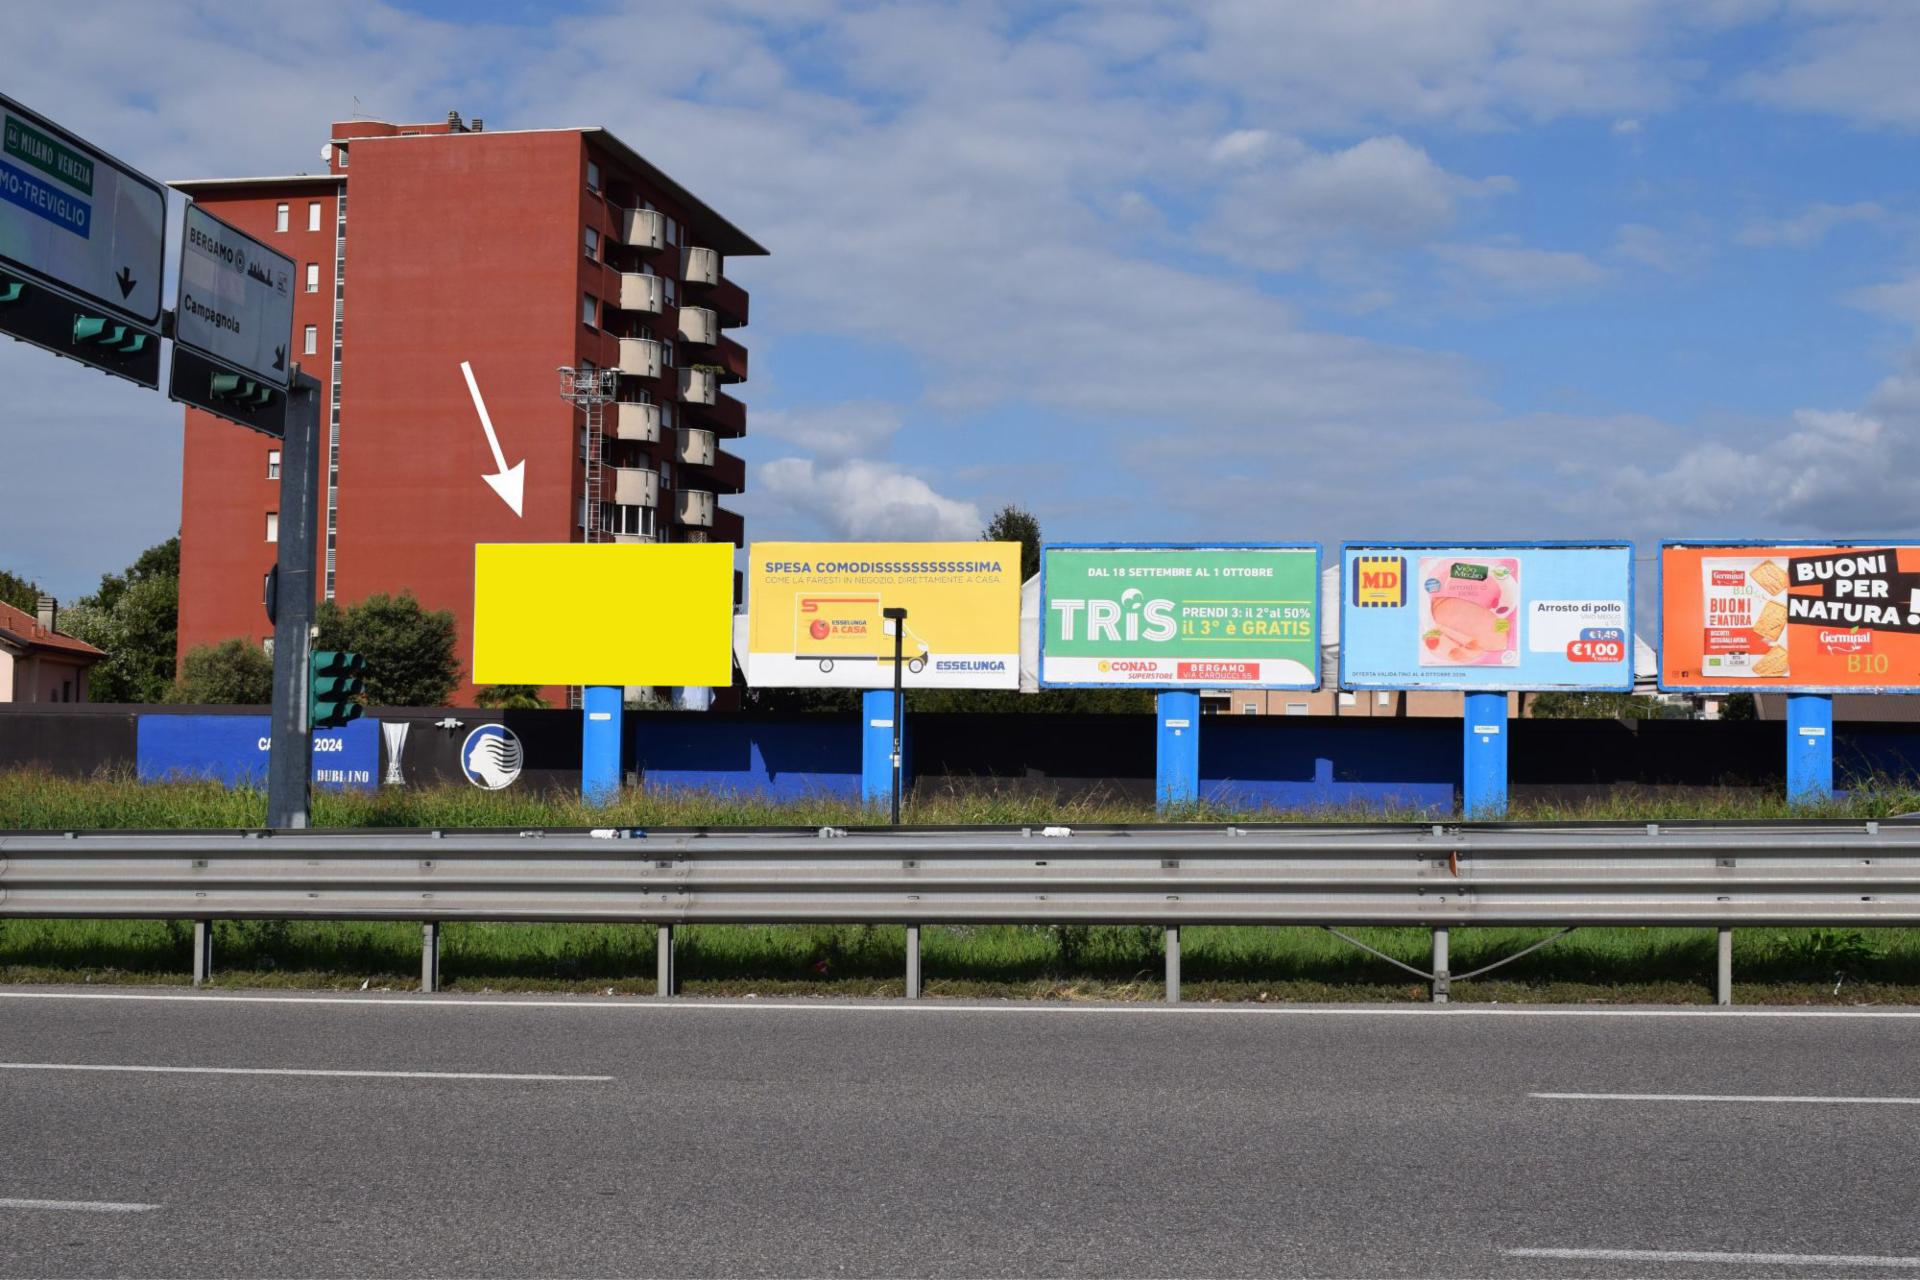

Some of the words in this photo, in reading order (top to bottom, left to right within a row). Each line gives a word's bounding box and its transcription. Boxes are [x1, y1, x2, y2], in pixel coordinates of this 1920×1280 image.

[21, 132, 53, 164] MILANO
[57, 152, 90, 185] VENEZIA
[190, 228, 233, 264] BERGAMO
[184, 294, 240, 333] Campagnola
[765, 562, 811, 573] SPESA
[1088, 567, 1109, 577] DAL
[1113, 567, 1125, 577] 18
[1129, 567, 1192, 577] SETTEMBRE
[1195, 567, 1210, 577] AL
[1214, 567, 1219, 577] 1
[1223, 567, 1273, 577] OTTOBRE
[1796, 555, 1887, 581] BUONI
[765, 576, 790, 584] COME
[792, 576, 804, 584] LA
[806, 576, 841, 584] FARESTI
[898, 576, 964, 584] DIRETTAMENTE
[975, 575, 1000, 583] CASA
[1362, 572, 1398, 589] MD
[1712, 570, 1744, 580] Germinal
[1733, 585, 1753, 595] BIO
[1836, 579, 1889, 598] PER
[1538, 603, 1579, 612] Arrosto
[1581, 603, 1591, 612] di
[1594, 603, 1621, 614] pollo
[1710, 598, 1751, 613] BUONI
[1183, 607, 1228, 618] PRENDI
[1231, 607, 1242, 618] 3:
[1245, 607, 1253, 618] il
[1284, 607, 1311, 618] 50%
[1718, 614, 1752, 626] NATURA
[1183, 620, 1194, 634] il
[1200, 620, 1220, 635] 3°
[1242, 620, 1311, 635] GRATIS
[1819, 631, 1870, 643] Germinal
[936, 661, 1005, 671] ESSELUNGA
[1111, 662, 1157, 671] CONAD
[1191, 664, 1245, 672] BERGAMO
[1847, 653, 1889, 674] BIO
[1128, 672, 1174, 680] SUPERSTORE
[314, 738, 343, 752] 2024
[317, 769, 369, 783] DUBLINO
